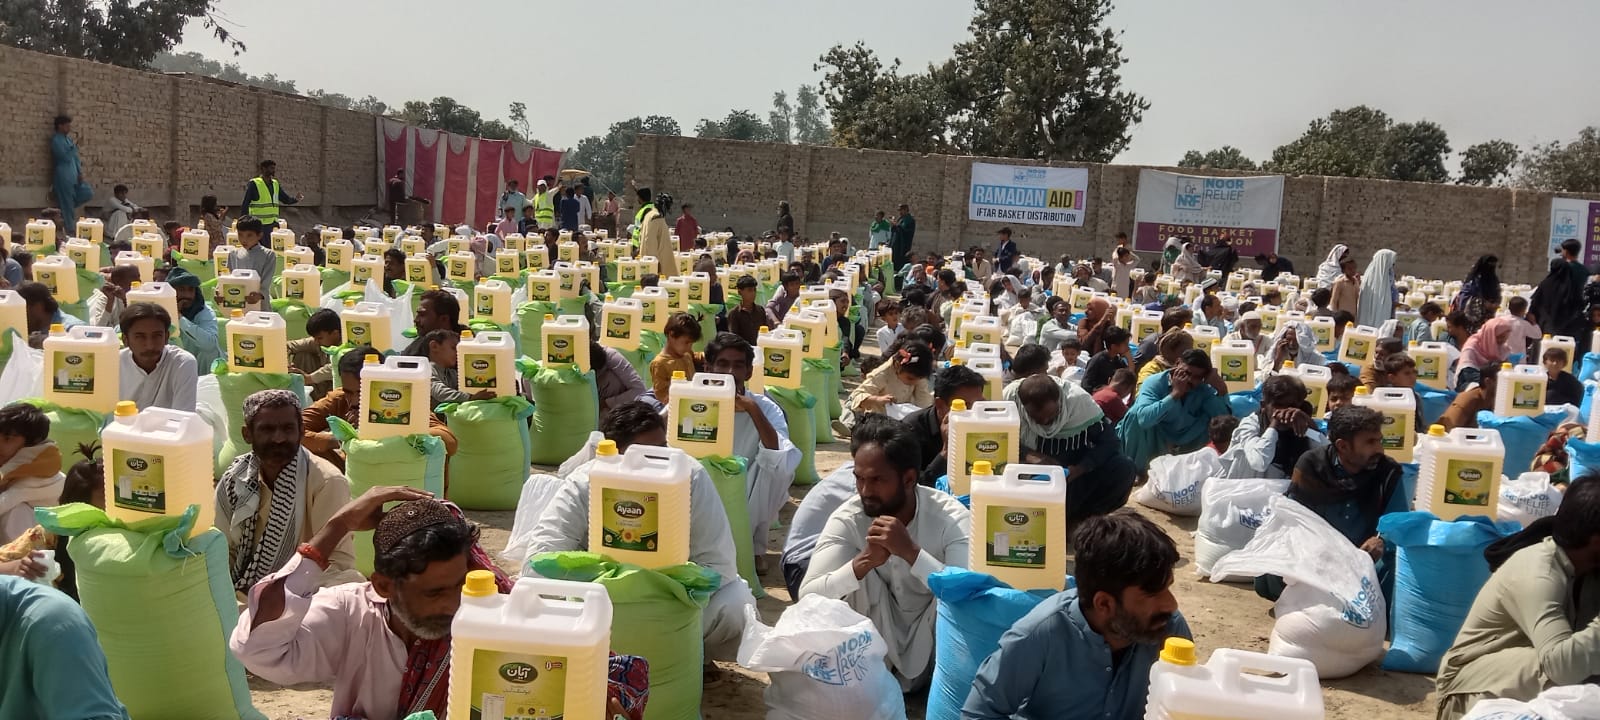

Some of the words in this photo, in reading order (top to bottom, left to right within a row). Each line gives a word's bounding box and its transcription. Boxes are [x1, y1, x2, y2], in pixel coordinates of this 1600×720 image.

[1205, 178, 1244, 189] NOOR
[975, 185, 1045, 207] RAMADAN
[1048, 190, 1073, 208] AID
[1177, 194, 1201, 207] NRF
[1205, 189, 1245, 200] RELIEF
[1204, 201, 1243, 213] FUND
[976, 207, 997, 218] IFTAR
[997, 208, 1026, 220] BASKET
[1027, 211, 1077, 223] DISTRIBUTION
[1159, 224, 1194, 234] FOOD
[1202, 227, 1256, 236] BASKET
[380, 392, 400, 400] Ayaan
[616, 505, 642, 515] Ayaan
